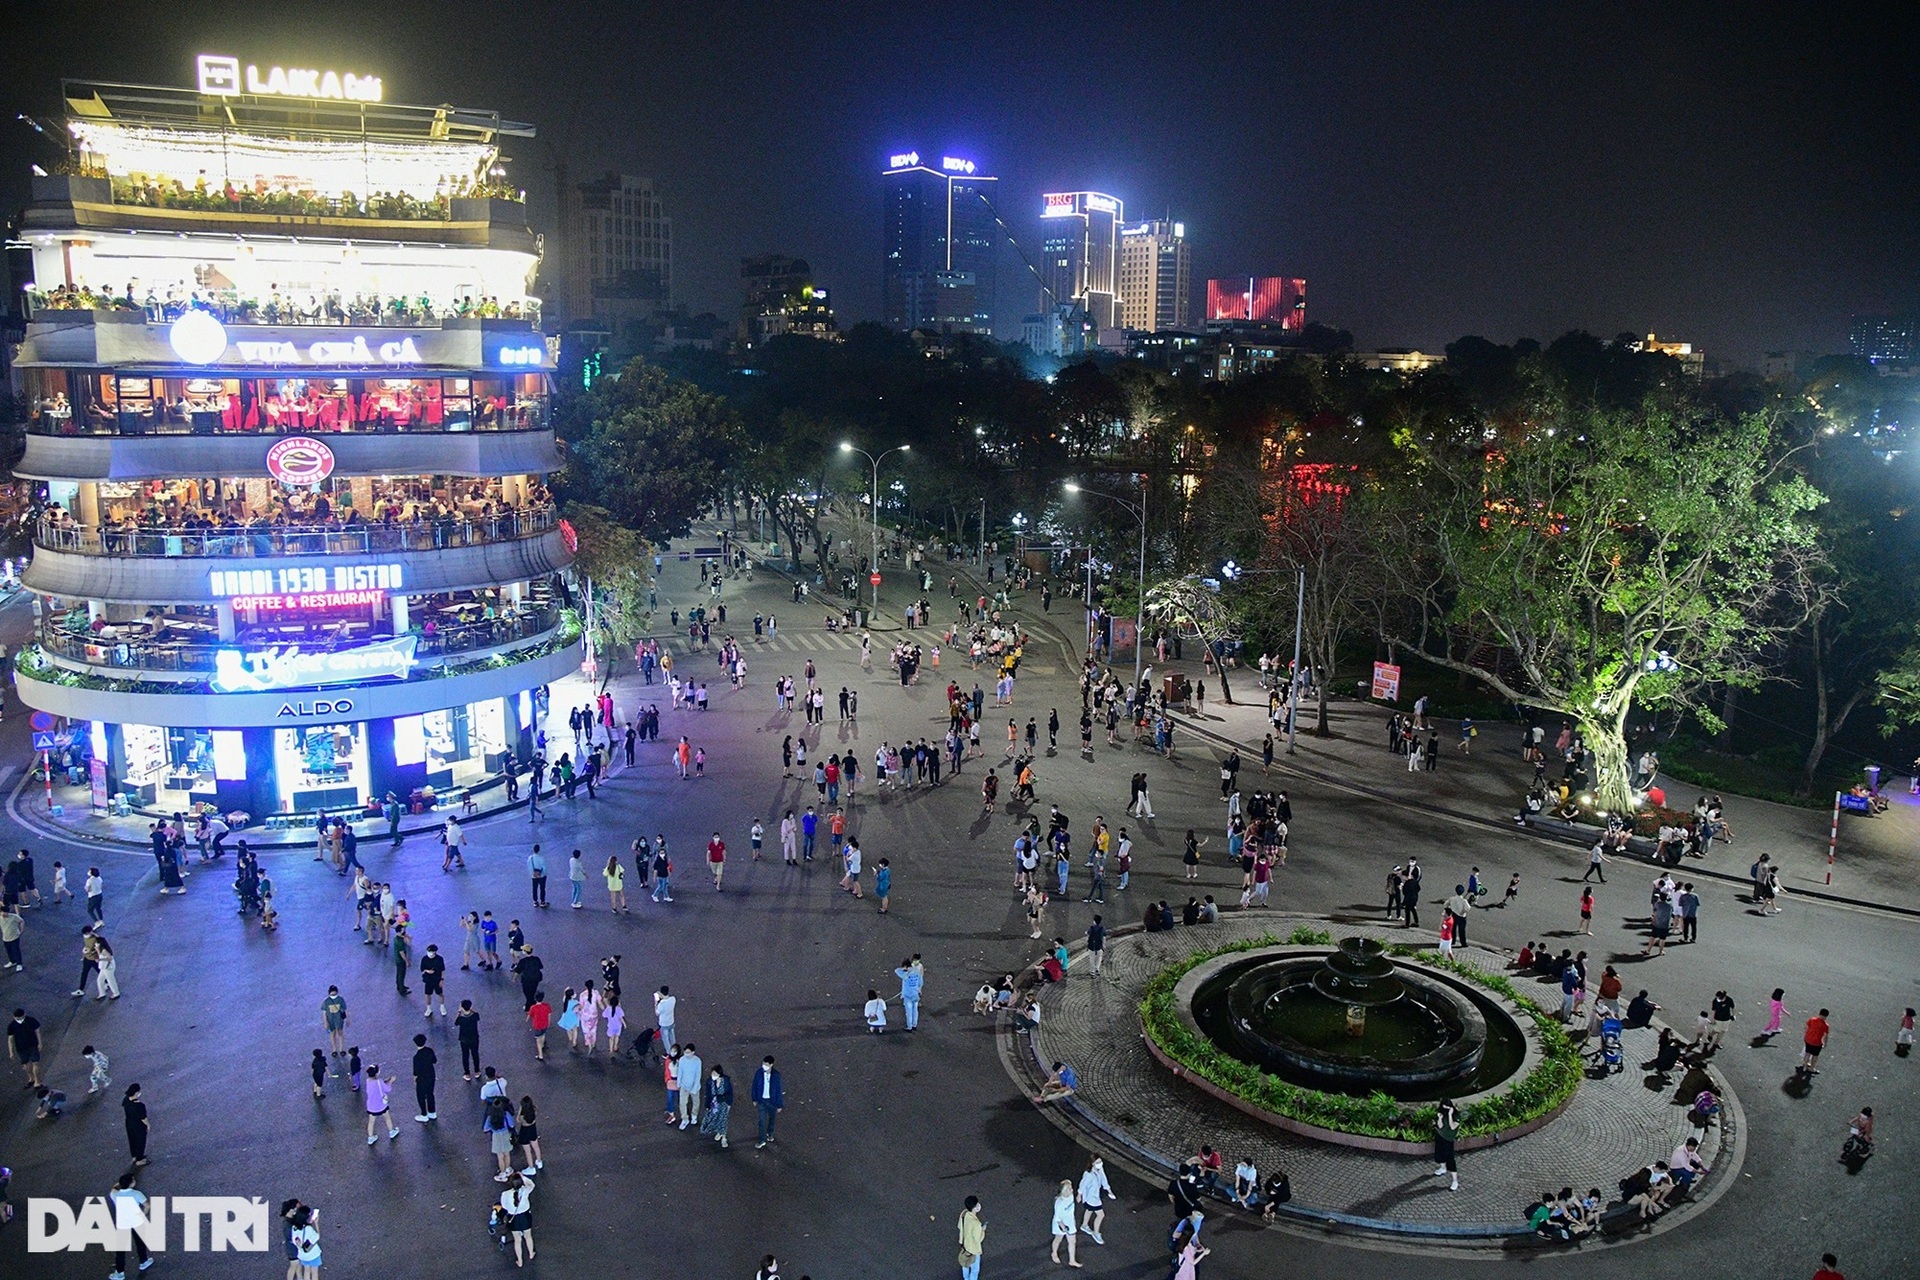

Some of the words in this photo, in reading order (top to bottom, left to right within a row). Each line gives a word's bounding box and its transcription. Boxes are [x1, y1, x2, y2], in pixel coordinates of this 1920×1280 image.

[247, 64, 342, 98] LAIKA
[1048, 194, 1073, 206] BRG
[270, 439, 331, 461] HIGHLANDS
[278, 469, 325, 483] COFFEE
[210, 569, 273, 596] HANOI
[279, 567, 327, 593] 1930
[334, 563, 402, 591] BISTRO
[232, 596, 282, 610] COFFEE
[286, 595, 296, 609] &
[300, 590, 384, 608] RESTAURANT
[329, 650, 418, 670] CRYSTAL
[276, 698, 353, 718] ALDO
